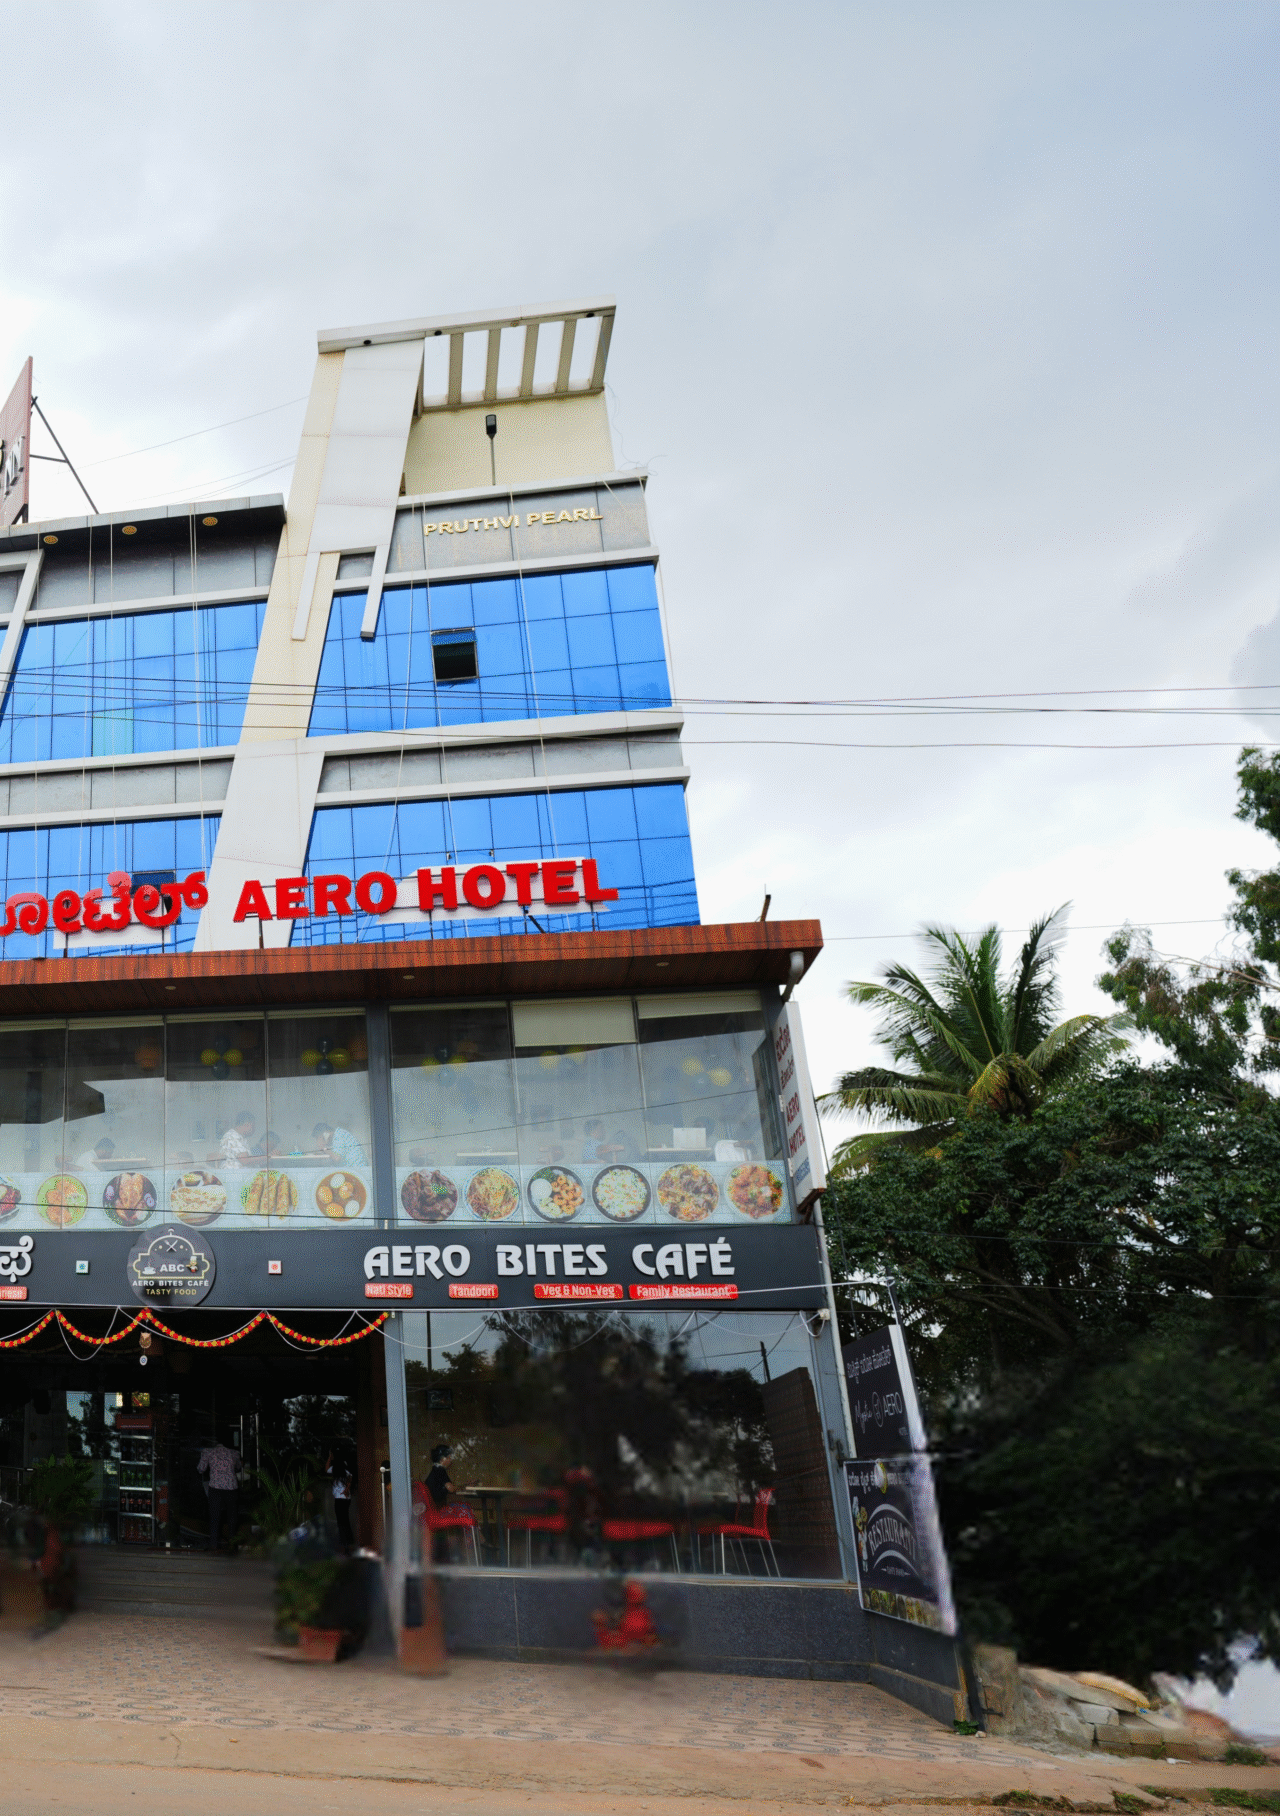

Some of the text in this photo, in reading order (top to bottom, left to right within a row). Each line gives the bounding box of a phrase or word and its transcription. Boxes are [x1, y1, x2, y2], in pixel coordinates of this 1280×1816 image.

[423, 507, 604, 537] PRUTHVI PEARL
[232, 858, 619, 923] AERO HOTEL
[363, 1236, 736, 1281] AERO BITES CAFÉ
[159, 1263, 185, 1273] ABC
[187, 1278, 209, 1287] CAFÉ
[145, 1288, 171, 1296] TASTY
[388, 1284, 412, 1298] Style
[451, 1285, 496, 1297] Tandoori
[541, 1285, 616, 1298] Veg & Non-Veg
[636, 1285, 731, 1299] Family Restaurant
[883, 1391, 903, 1417] AERO
